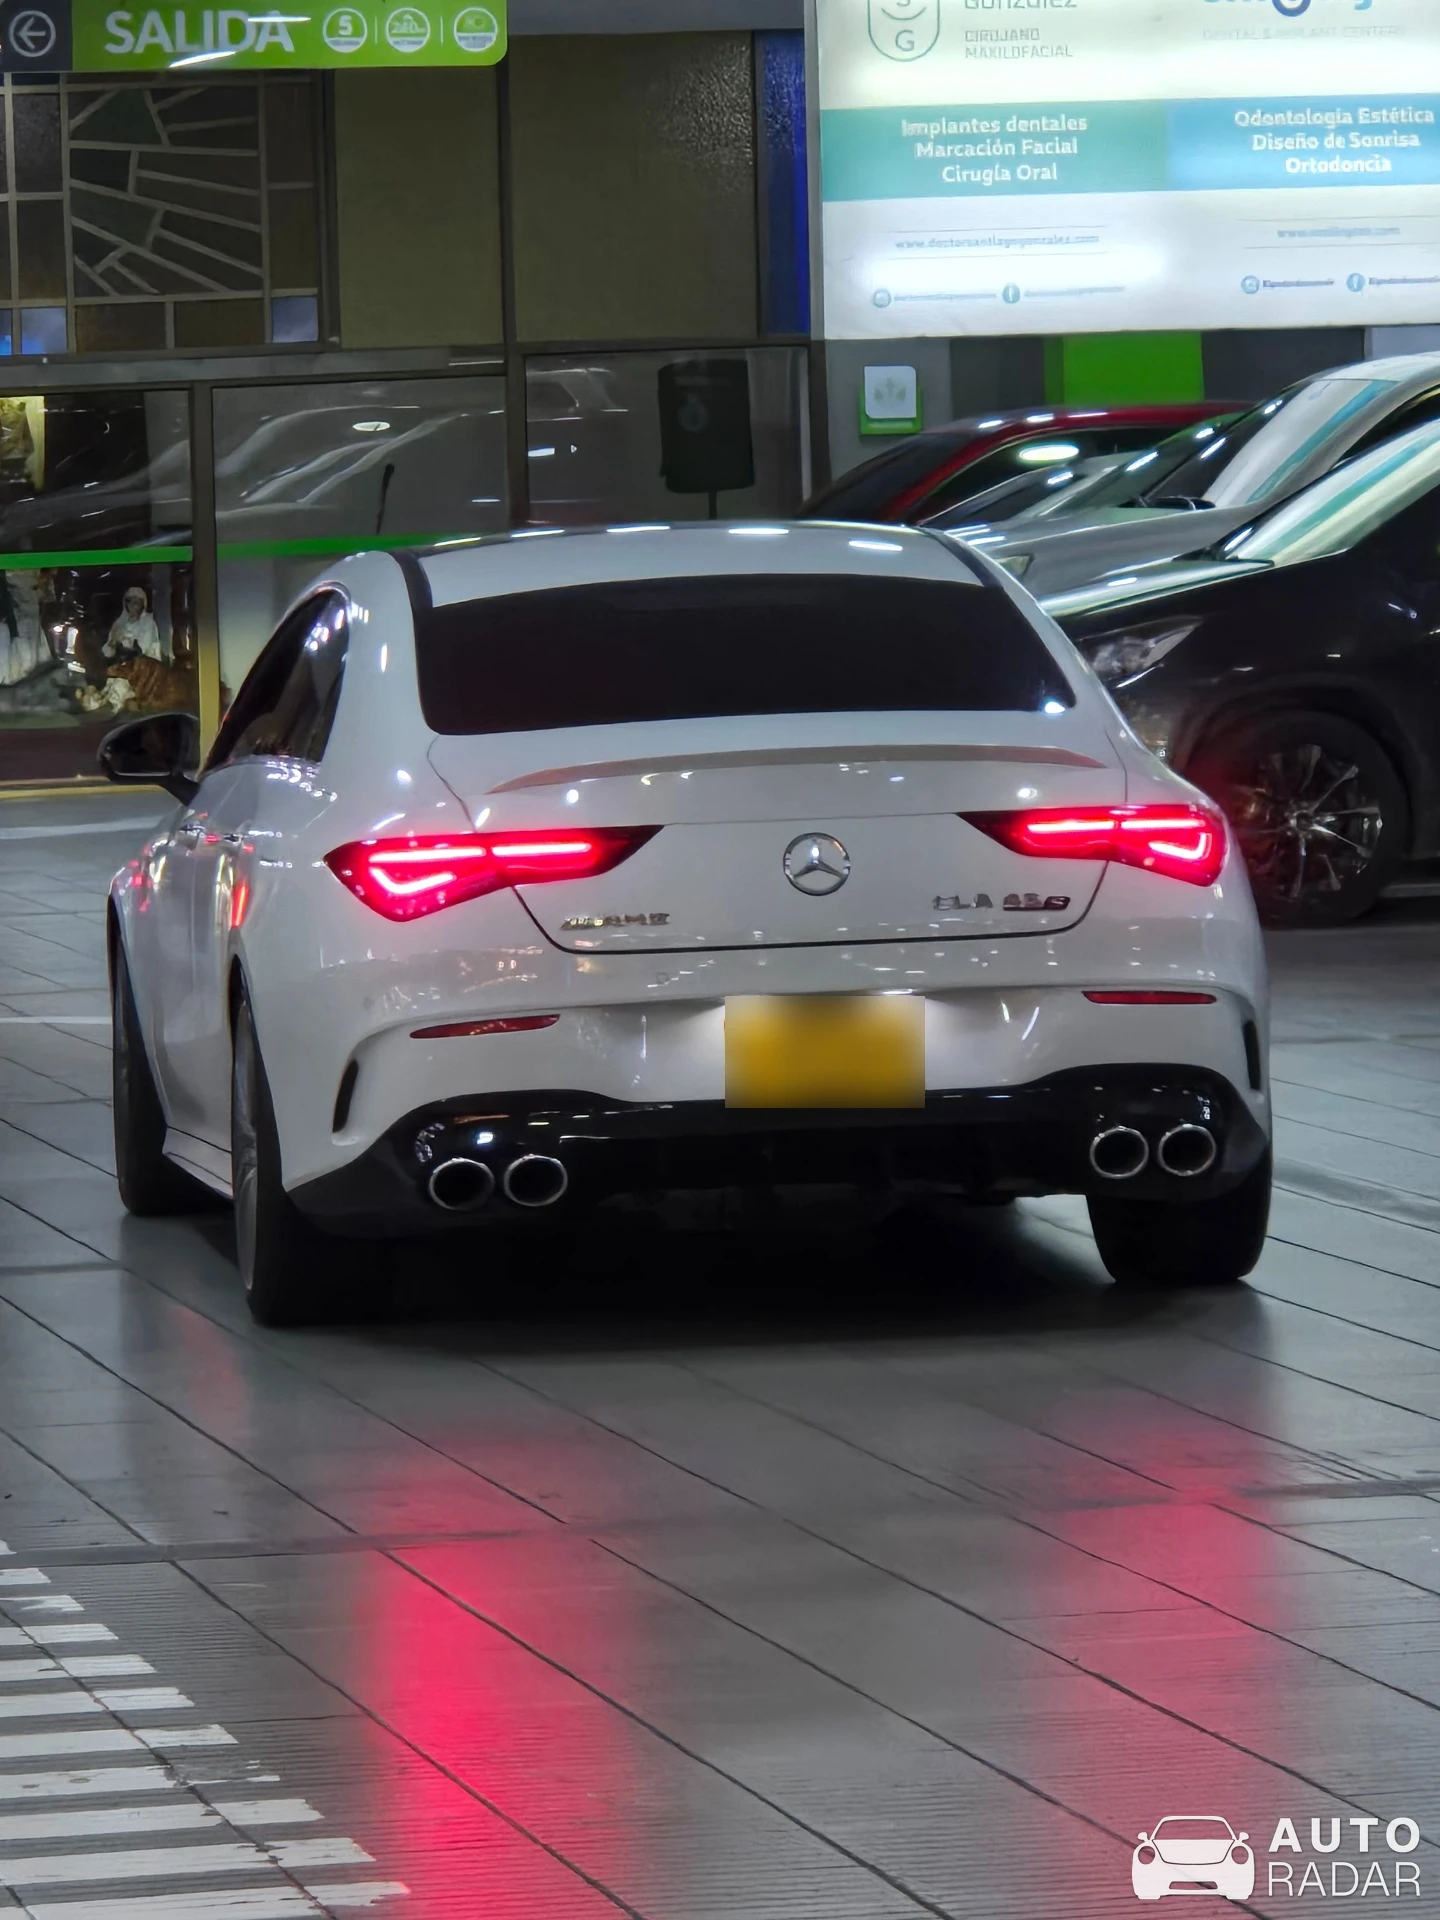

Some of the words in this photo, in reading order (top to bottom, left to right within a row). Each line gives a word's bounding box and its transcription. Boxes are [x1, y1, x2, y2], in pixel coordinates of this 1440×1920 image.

[104, 9, 295, 54] SALIDA
[895, 29, 915, 52] G
[901, 117, 1000, 138] Implantes
[1006, 114, 1088, 133] dentales
[1358, 107, 1435, 124] Estética
[915, 138, 1015, 158] Marcación
[1021, 136, 1078, 155] Facial
[1252, 133, 1319, 151] Diseño
[1324, 131, 1346, 149] de
[1349, 130, 1421, 148] Sonrisa
[1016, 162, 1058, 181] Oral
